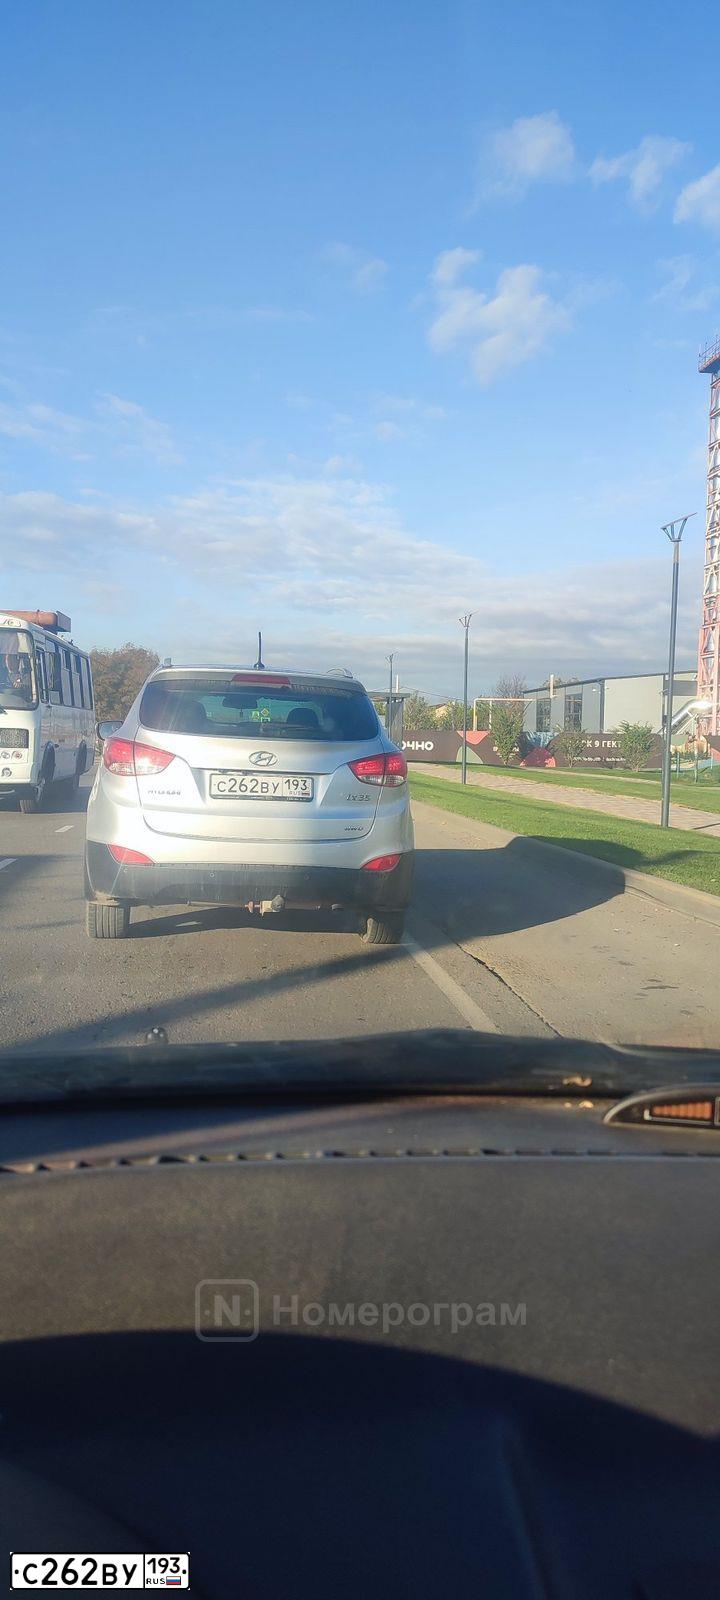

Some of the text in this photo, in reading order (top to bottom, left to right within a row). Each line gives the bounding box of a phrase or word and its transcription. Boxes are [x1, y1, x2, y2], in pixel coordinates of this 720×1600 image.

[594, 740, 600, 748] 9
[217, 778, 308, 794] С262ВУ 193
